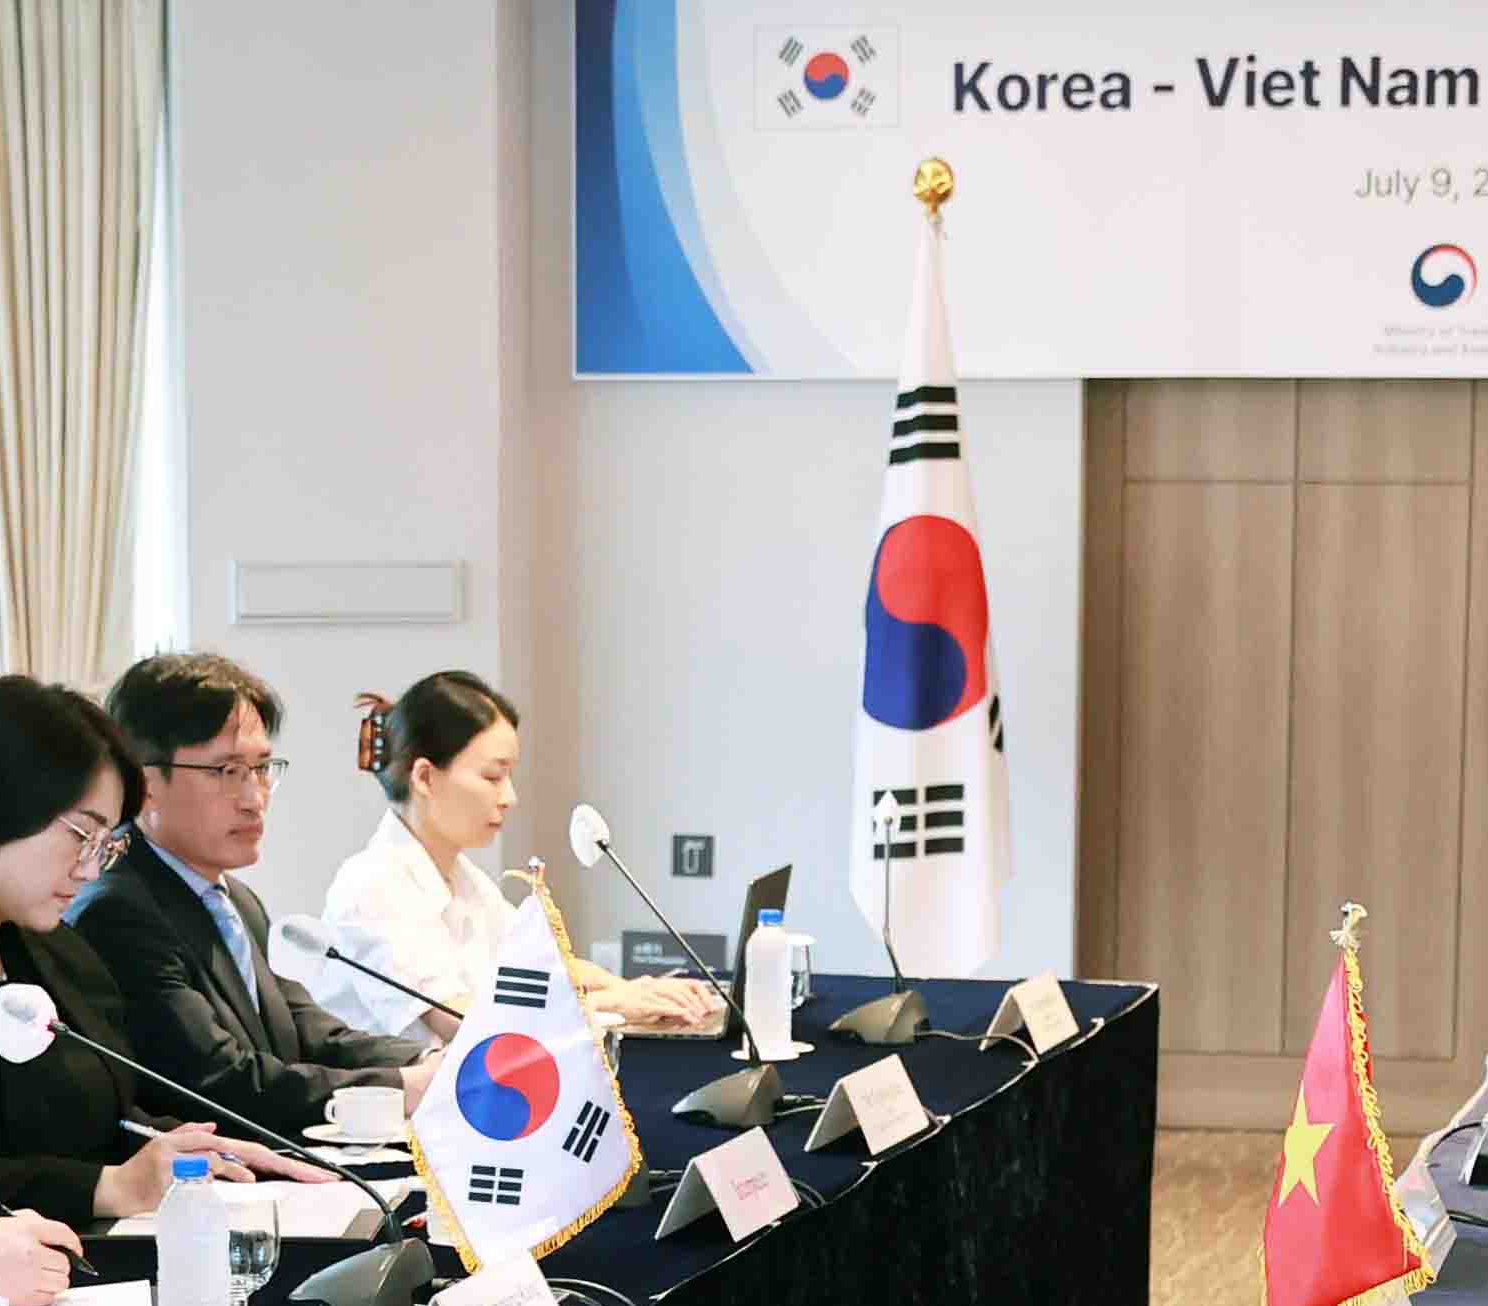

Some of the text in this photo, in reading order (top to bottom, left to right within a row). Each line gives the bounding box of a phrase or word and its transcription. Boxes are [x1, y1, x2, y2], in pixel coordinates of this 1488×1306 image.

[952, 60, 1132, 113] Korea
[1195, 53, 1322, 109] Viet
[1339, 54, 1480, 108] Nam
[1354, 167, 1421, 205] July
[1430, 167, 1460, 203] 9,
